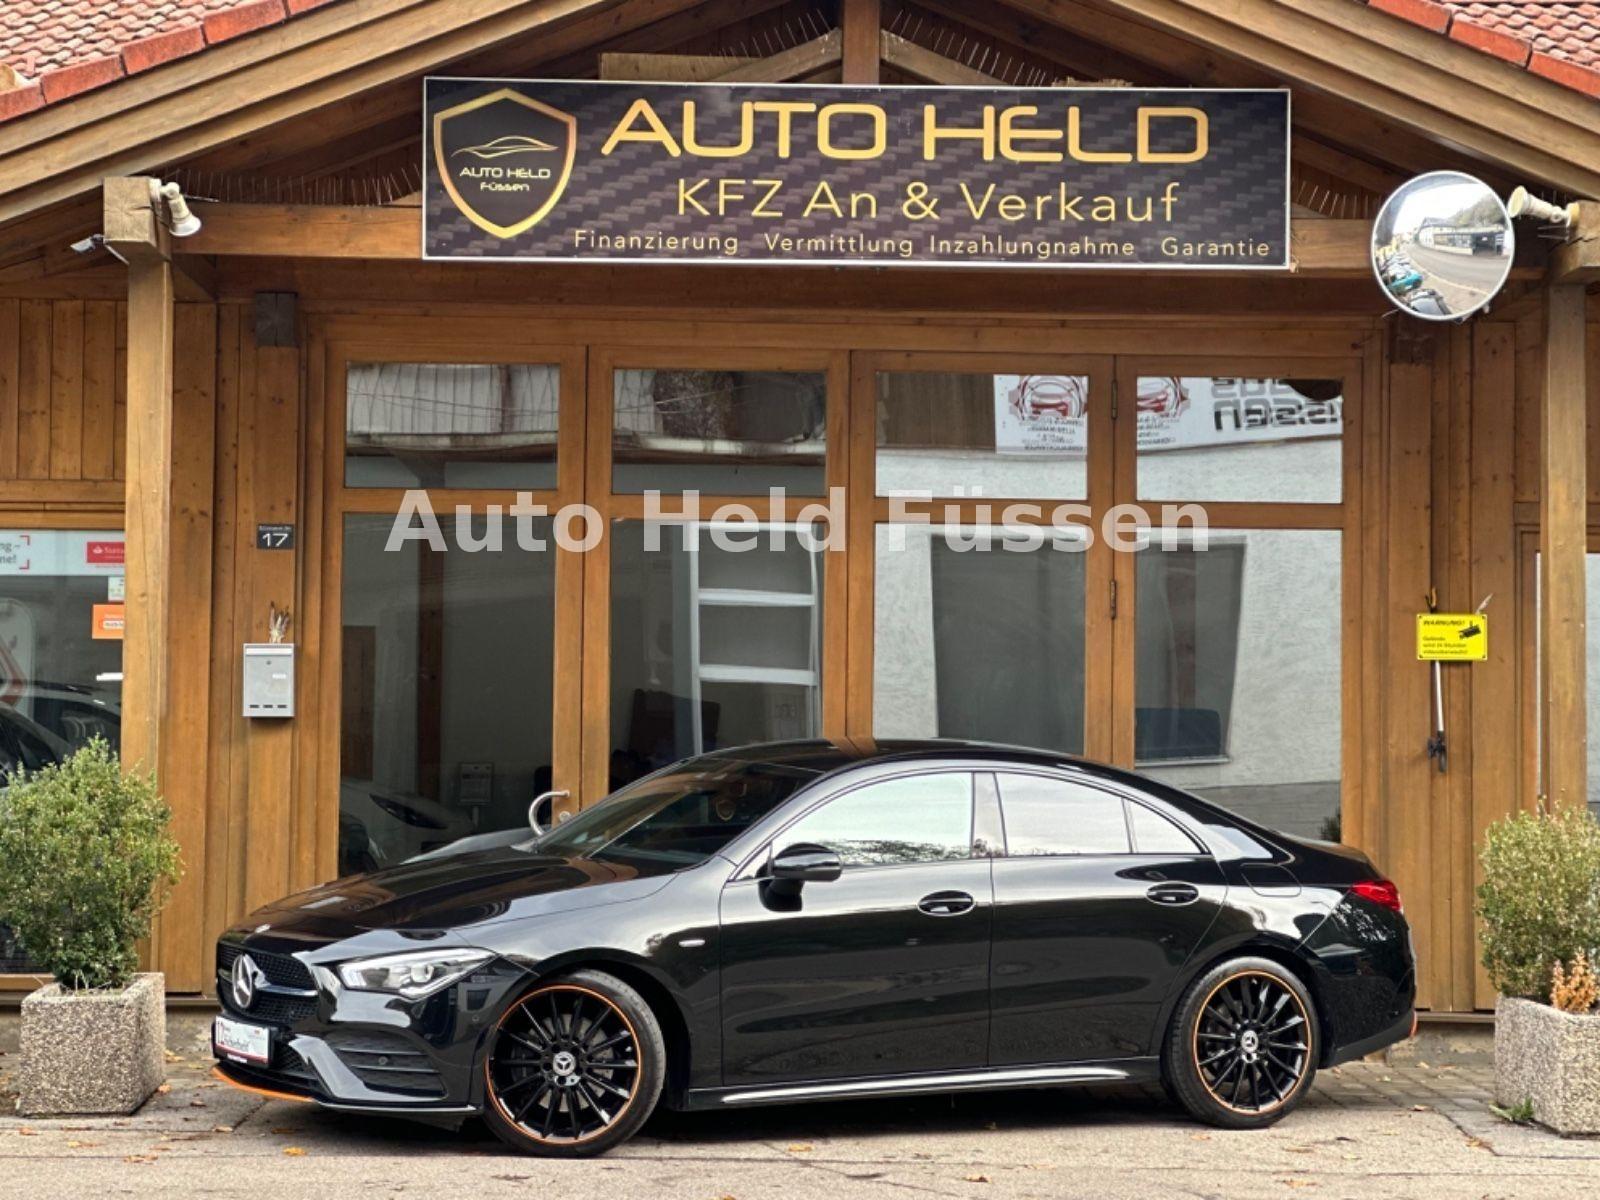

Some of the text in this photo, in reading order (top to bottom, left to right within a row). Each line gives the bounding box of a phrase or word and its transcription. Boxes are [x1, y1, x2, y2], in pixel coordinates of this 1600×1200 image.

[601, 98, 1209, 164] AUTO HELD
[459, 166, 551, 179] AUTO HELD
[480, 181, 530, 192] Füssen
[678, 178, 1180, 222] KFZ An & Verkauf
[573, 229, 1271, 260] Finanzierung Vermittlung Inzahlungnahme Garantie
[262, 533, 289, 548] 17
